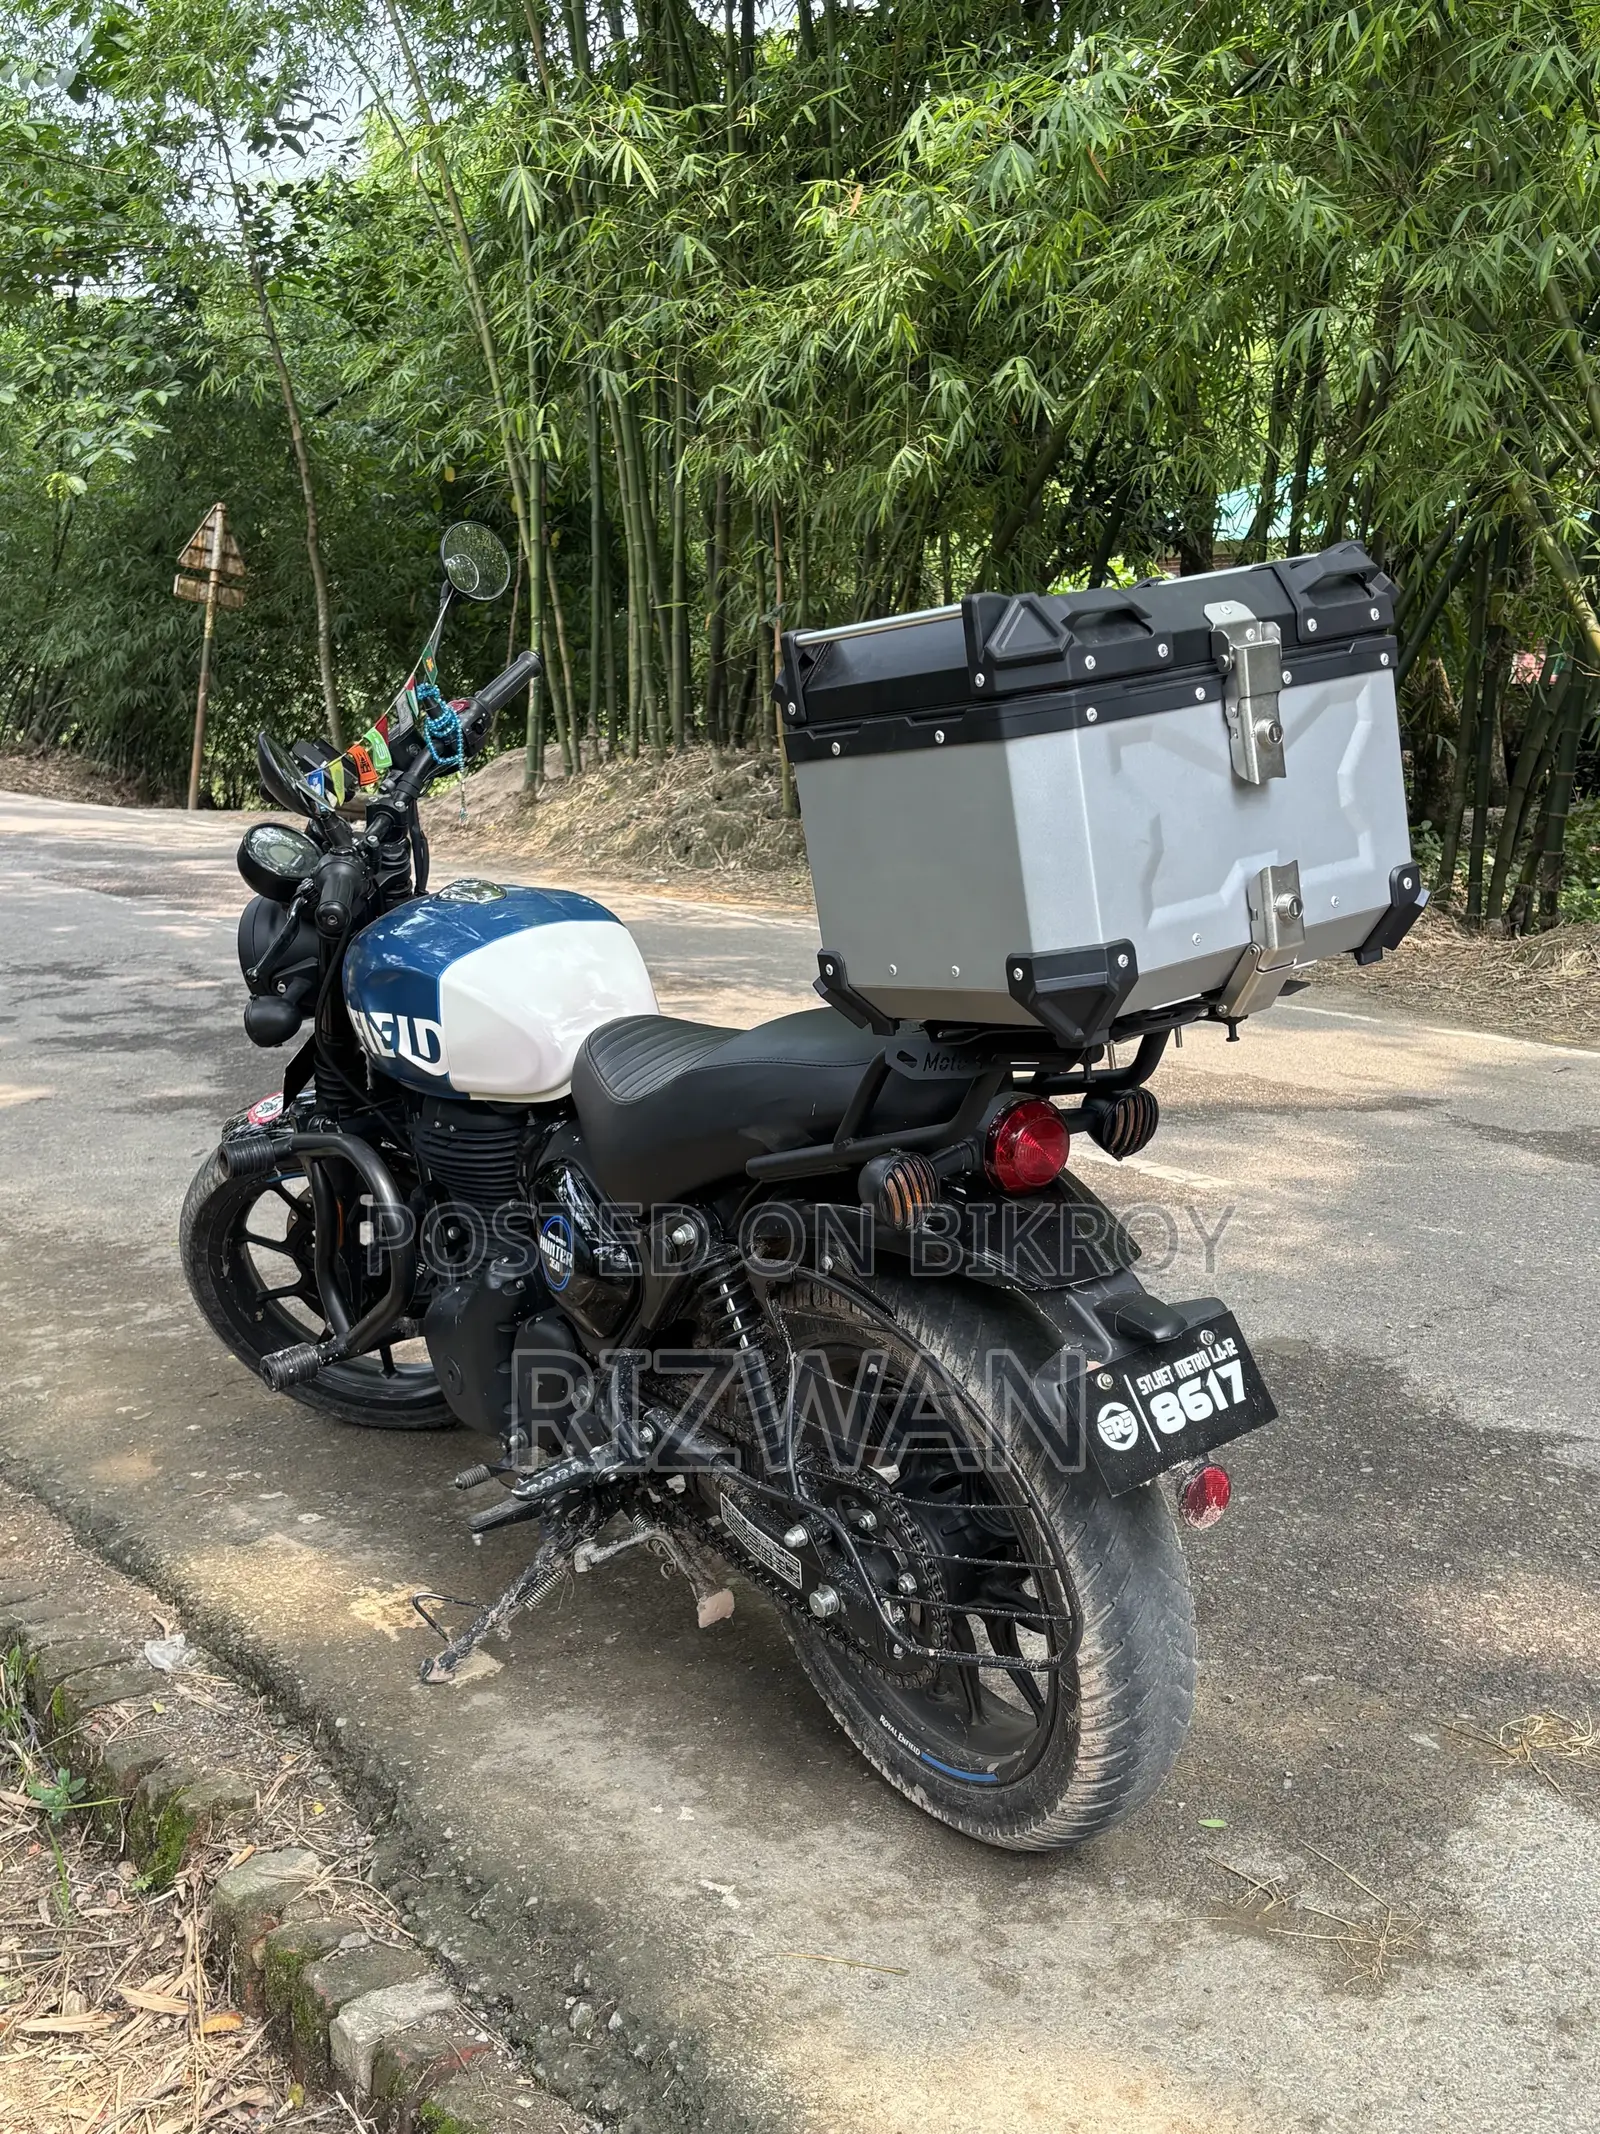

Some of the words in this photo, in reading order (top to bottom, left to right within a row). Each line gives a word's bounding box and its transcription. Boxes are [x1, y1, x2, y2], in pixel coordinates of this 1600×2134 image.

[539, 1234, 573, 1268] HUNTER
[1136, 1366, 1175, 1396] SYLHET
[1173, 1350, 1212, 1379] METRO
[1150, 1359, 1247, 1435] 8617
[879, 1714, 898, 1737] ROYAL
[897, 1732, 921, 1756] ENFIELD
